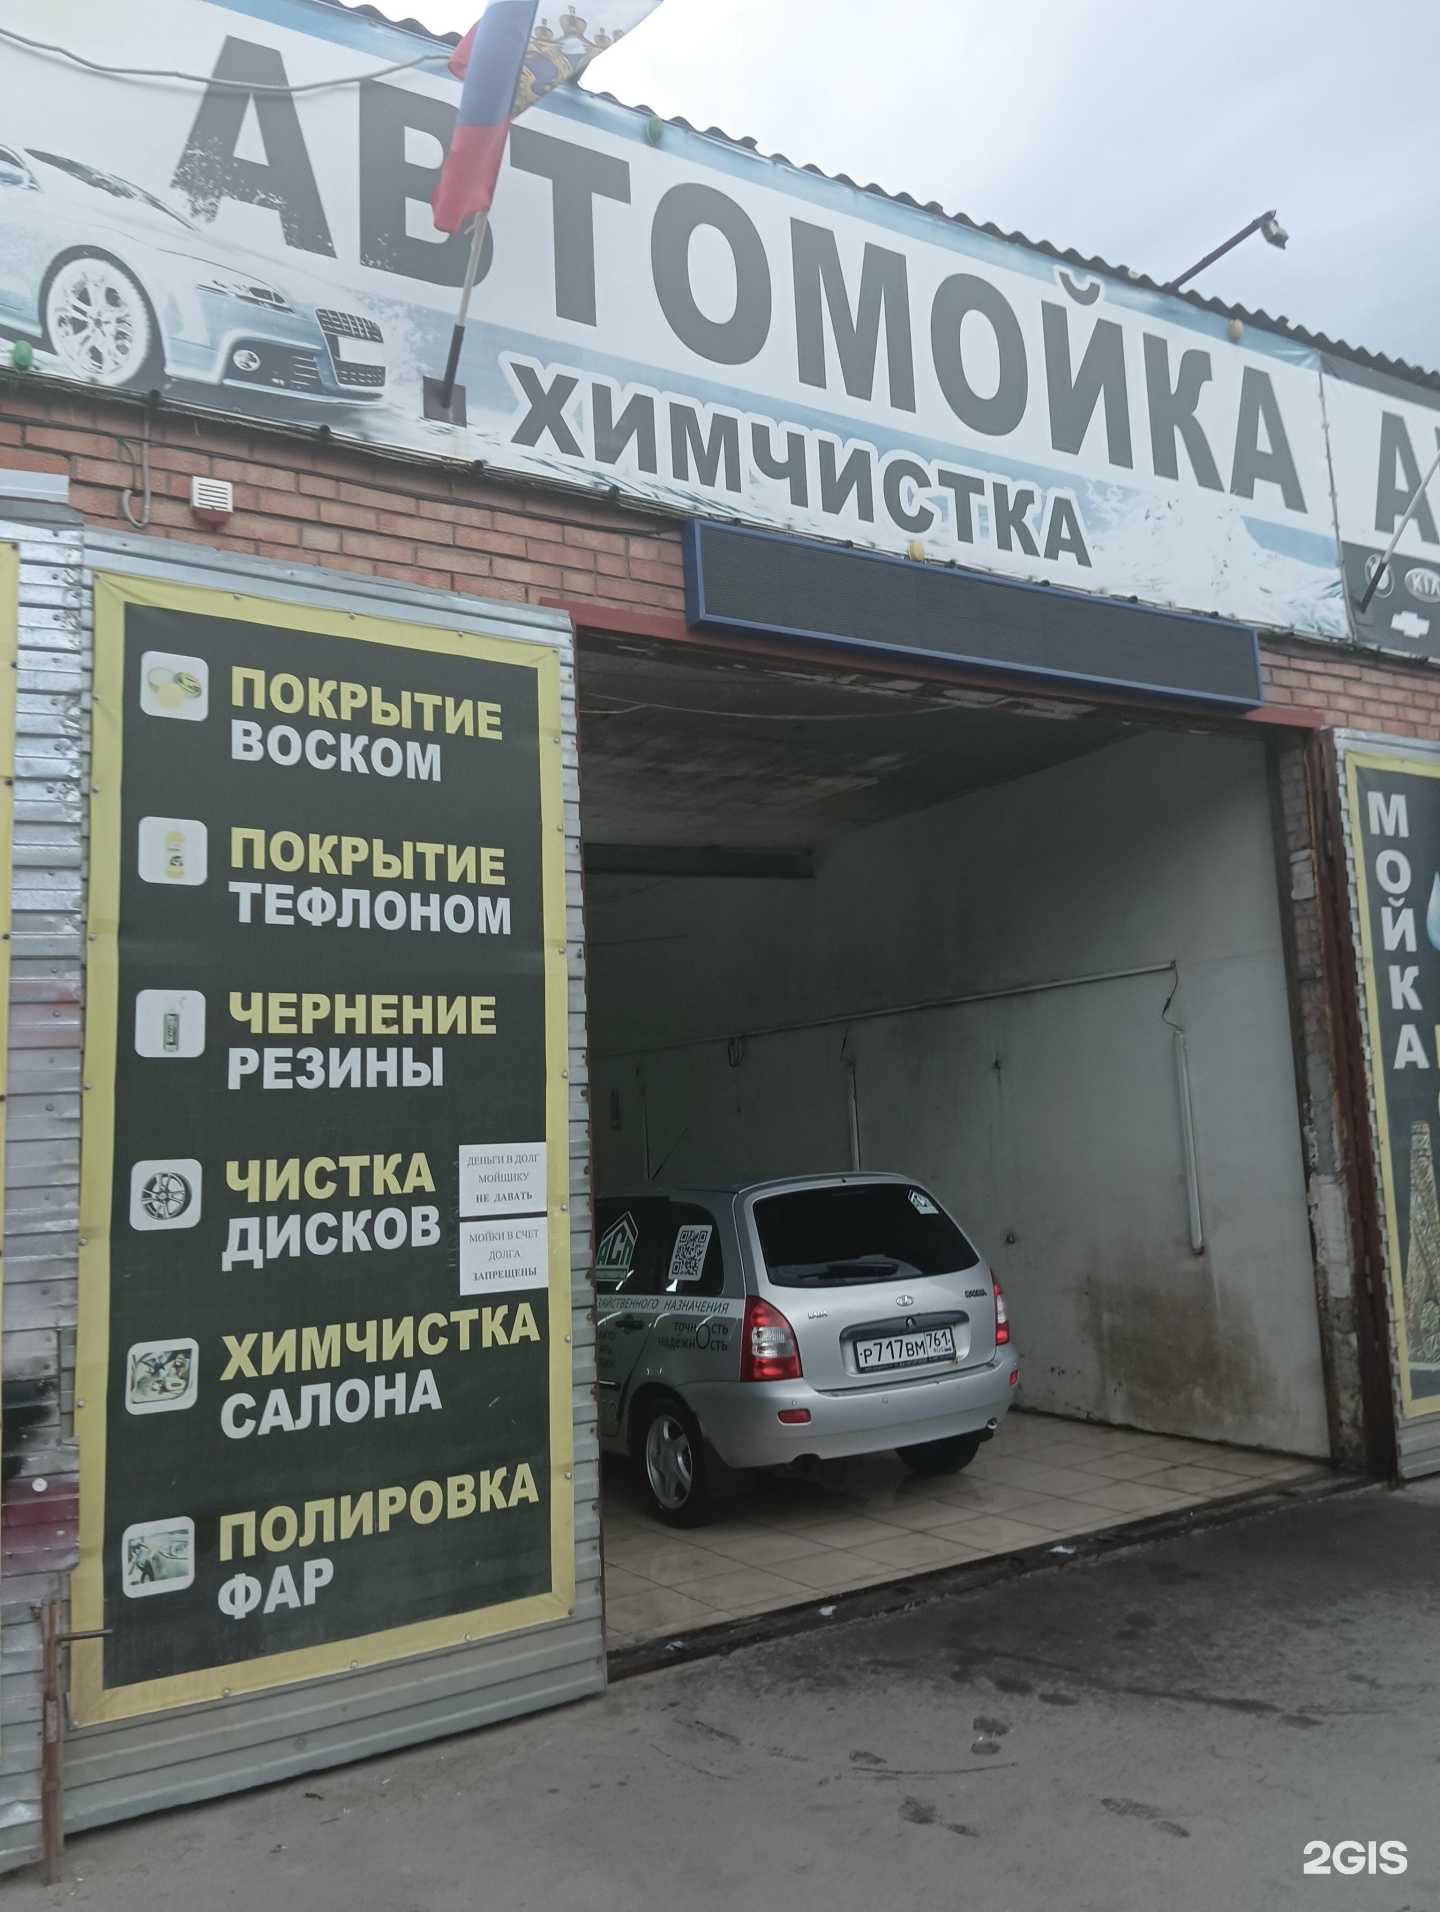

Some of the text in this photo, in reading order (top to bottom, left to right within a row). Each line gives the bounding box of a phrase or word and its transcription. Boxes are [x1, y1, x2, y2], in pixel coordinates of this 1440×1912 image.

[169, 34, 1308, 514] АВТОМОЙКА
[508, 362, 1093, 569] ХИМЧИСТКА
[231, 665, 503, 741] ПОКРЫТИЕ
[231, 719, 442, 782] ВОСКОМ
[230, 827, 506, 886] ПОКРЫТИЕ
[228, 881, 512, 935] ТЕФЛОНОМ
[1366, 790, 1431, 1071] МОЙКА
[228, 991, 497, 1035] ЧЕРНЕНИЕ
[227, 1047, 444, 1090] РЕЗИНЫ
[225, 1152, 436, 1203] ЧИСТКА
[467, 1153, 538, 1168] ДЕНЬГИ В ДОЛГ
[478, 1171, 529, 1184] МОЙЩИКУ
[475, 1191, 533, 1203] НЕ ДАВАТЬ
[221, 1205, 441, 1272] ДИСКОВ
[469, 1230, 505, 1243] МОЙКИ
[507, 1231, 514, 1240] В
[488, 1249, 520, 1262] ДОЛГА
[472, 1266, 537, 1281] ЗАПРЕЩЕНЫ
[663, 1299, 730, 1313] НАЗНАЧЕНИЯ
[219, 1302, 541, 1382] ХИМЧИСТКА
[926, 1331, 948, 1350] 761
[219, 1368, 443, 1440] САЛОНА
[219, 1462, 540, 1562] ПОЛИРОВКА
[217, 1557, 334, 1620] ФАР
